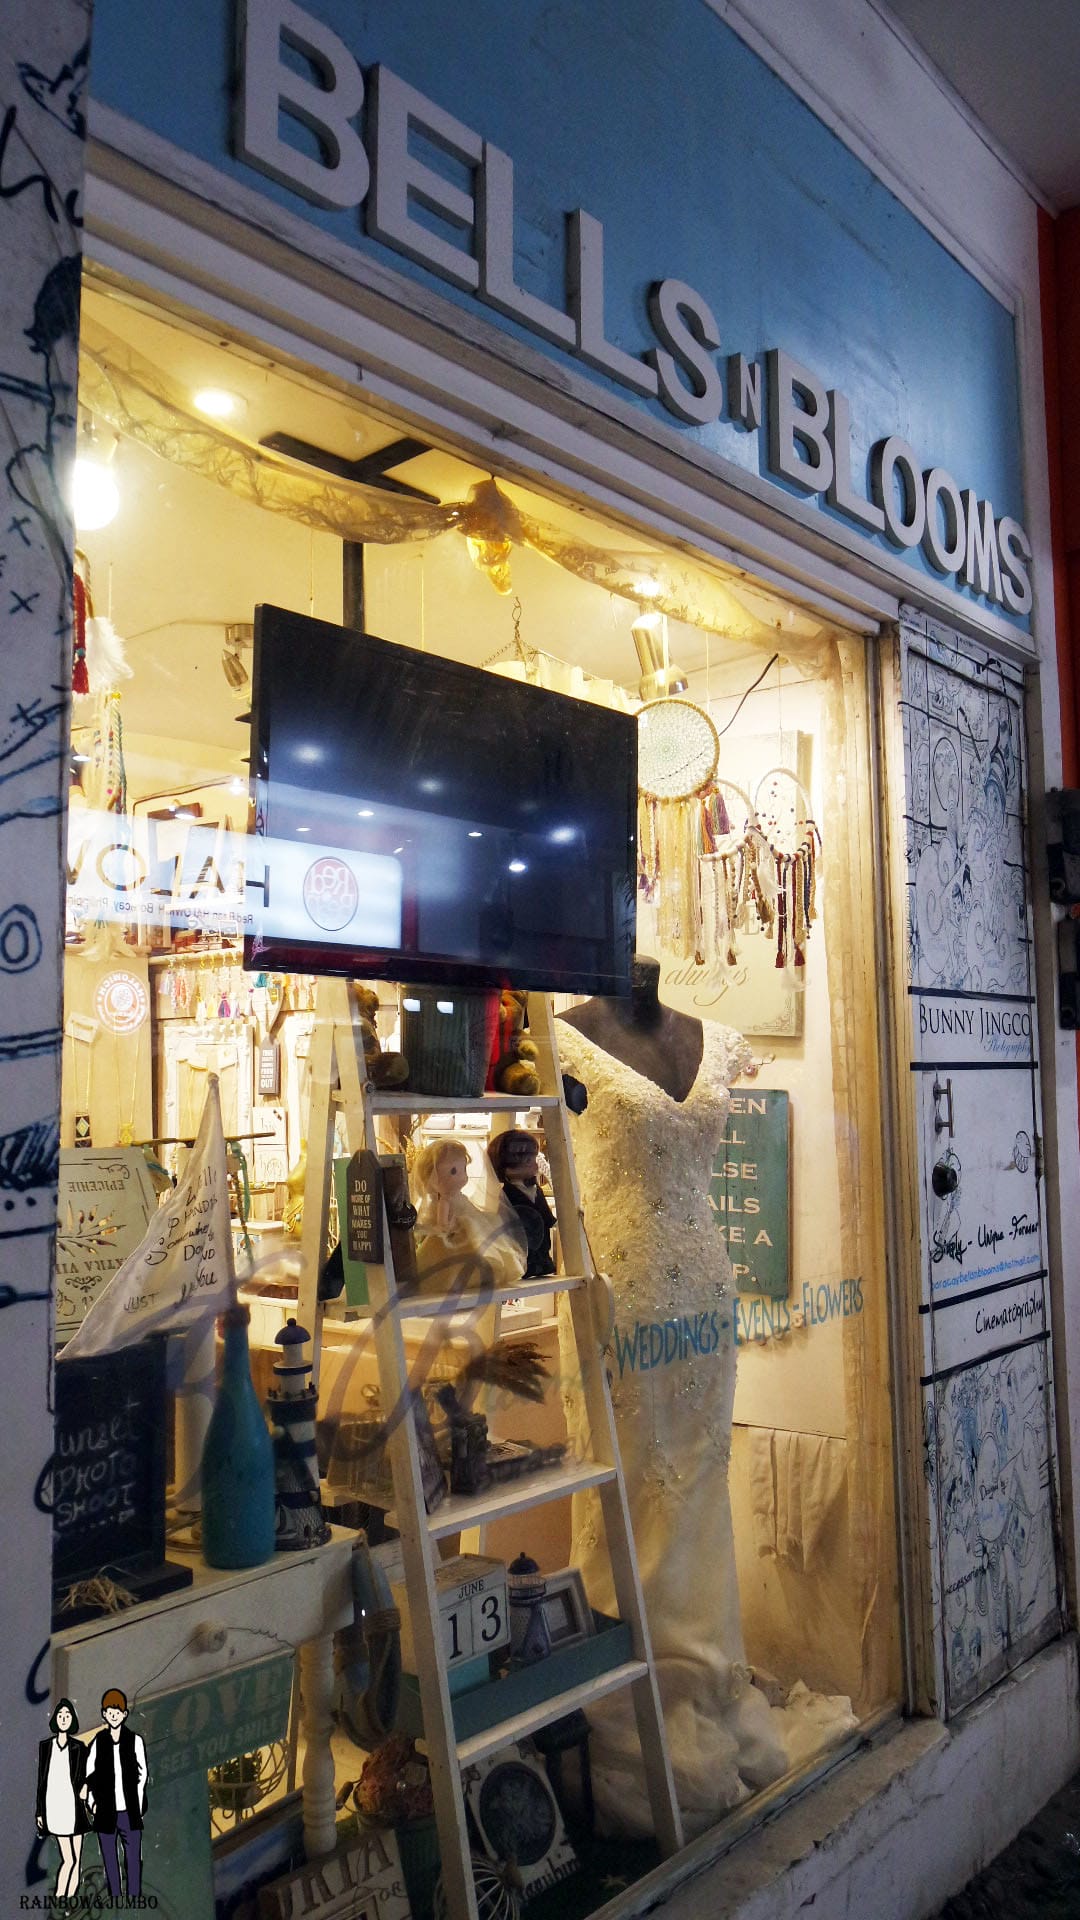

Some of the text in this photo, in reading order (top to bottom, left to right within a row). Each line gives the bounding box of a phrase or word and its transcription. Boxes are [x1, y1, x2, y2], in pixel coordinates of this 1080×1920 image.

[235, 0, 722, 427] BELLS
[768, 348, 1033, 616] BLOOMS
[920, 1003, 1031, 1042] BUNNY JINGCO
[729, 1097, 767, 1115] EN
[711, 1161, 758, 1180] LSE
[355, 1180, 367, 1192] DO
[353, 1205, 370, 1217] WHAT
[706, 1194, 760, 1214] AILS
[351, 1219, 372, 1229] MAKES
[352, 1240, 372, 1252] HAPPY
[753, 1229, 774, 1247] A
[123, 1292, 160, 1314] JUST
[613, 1309, 720, 1380] WEDDINGS
[733, 1296, 790, 1347] EVENTS
[802, 1276, 864, 1329] FLOWERS
[458, 1579, 484, 1599] JUNE
[197, 1733, 231, 1761] YOU
